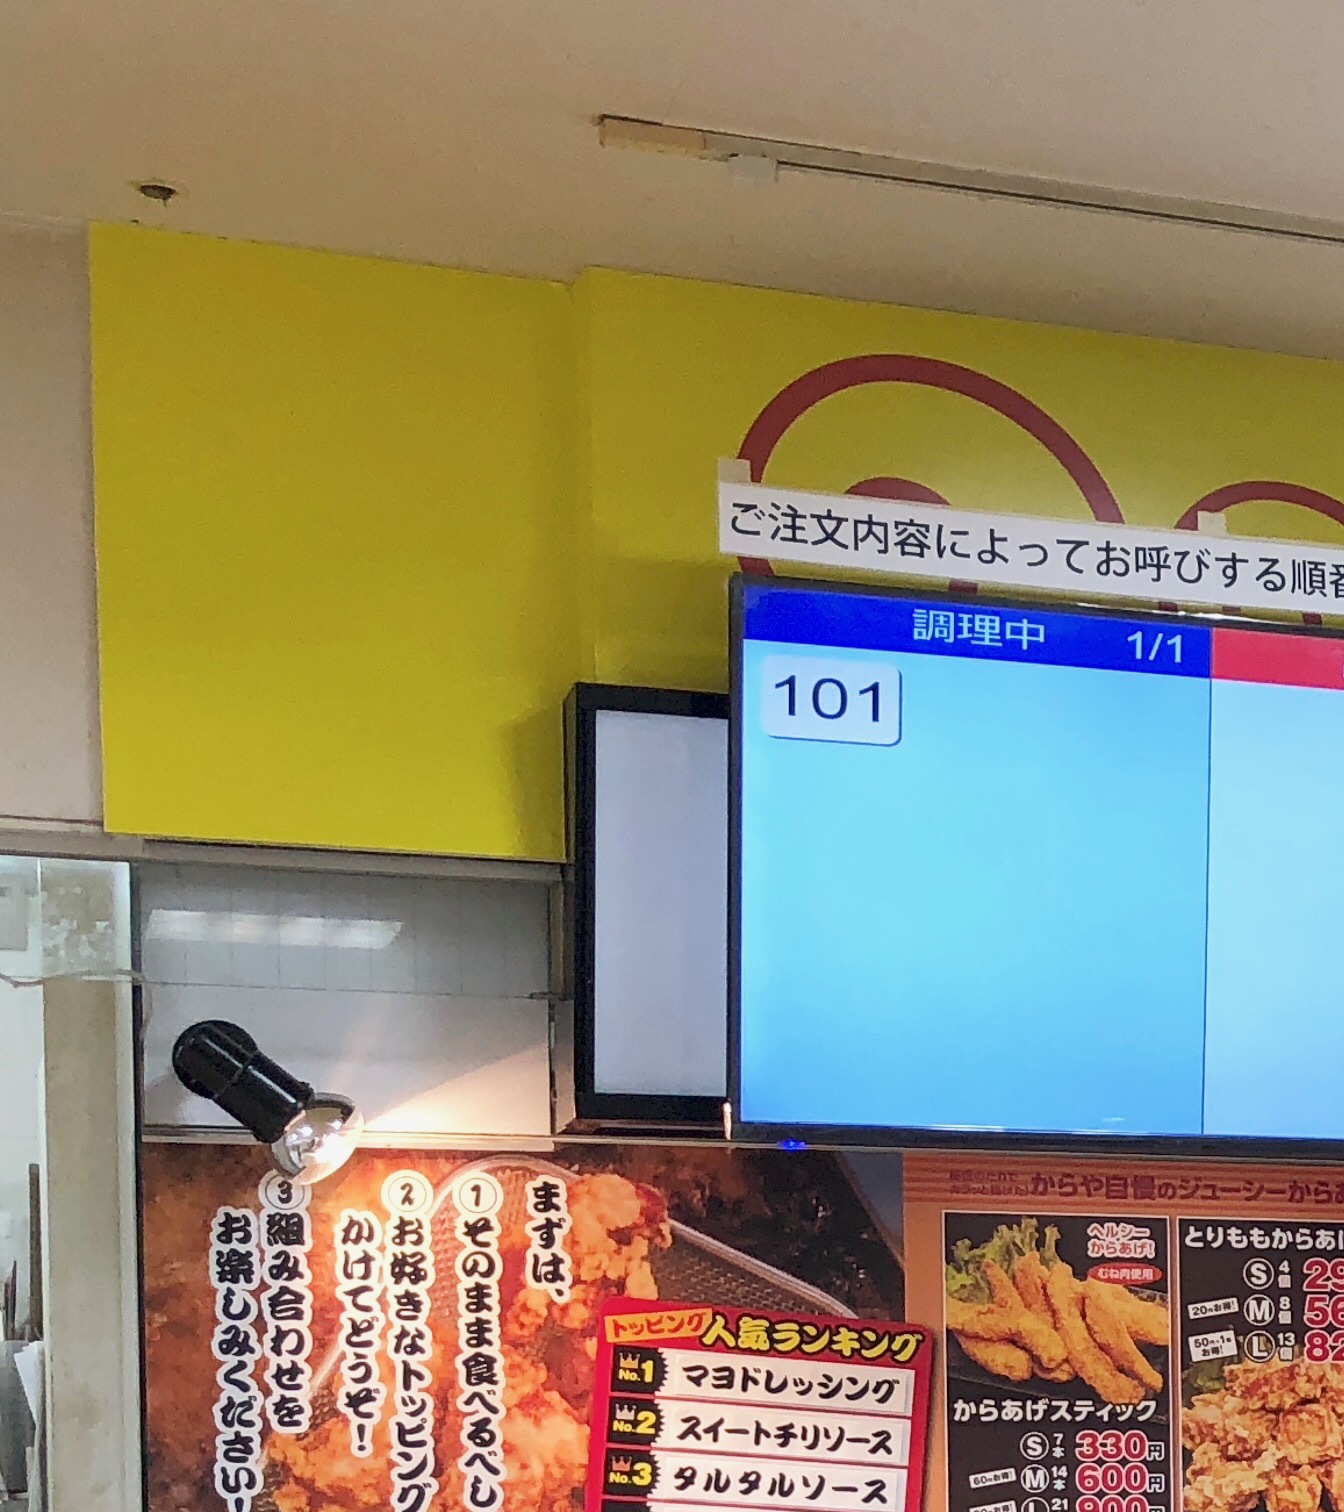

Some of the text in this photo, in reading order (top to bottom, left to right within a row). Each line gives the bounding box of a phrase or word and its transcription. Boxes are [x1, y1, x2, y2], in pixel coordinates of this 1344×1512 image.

[911, 608, 1185, 665] 調理中 1/1
[773, 673, 886, 724] 101
[530, 1181, 568, 1300] まずは、
[1089, 1224, 1149, 1238] ヘルシー
[611, 1311, 923, 1362] トッピング 人気ランキング
[618, 1361, 900, 1403] No.1 マヨドレッシング
[953, 1399, 1157, 1423] からあげスティック
[612, 1411, 893, 1455] No.2 スイートチリソース
[1075, 1430, 1164, 1461] 330円
[609, 1463, 888, 1504] No.3 タルタルソース
[1075, 1462, 1164, 1494] 600円
